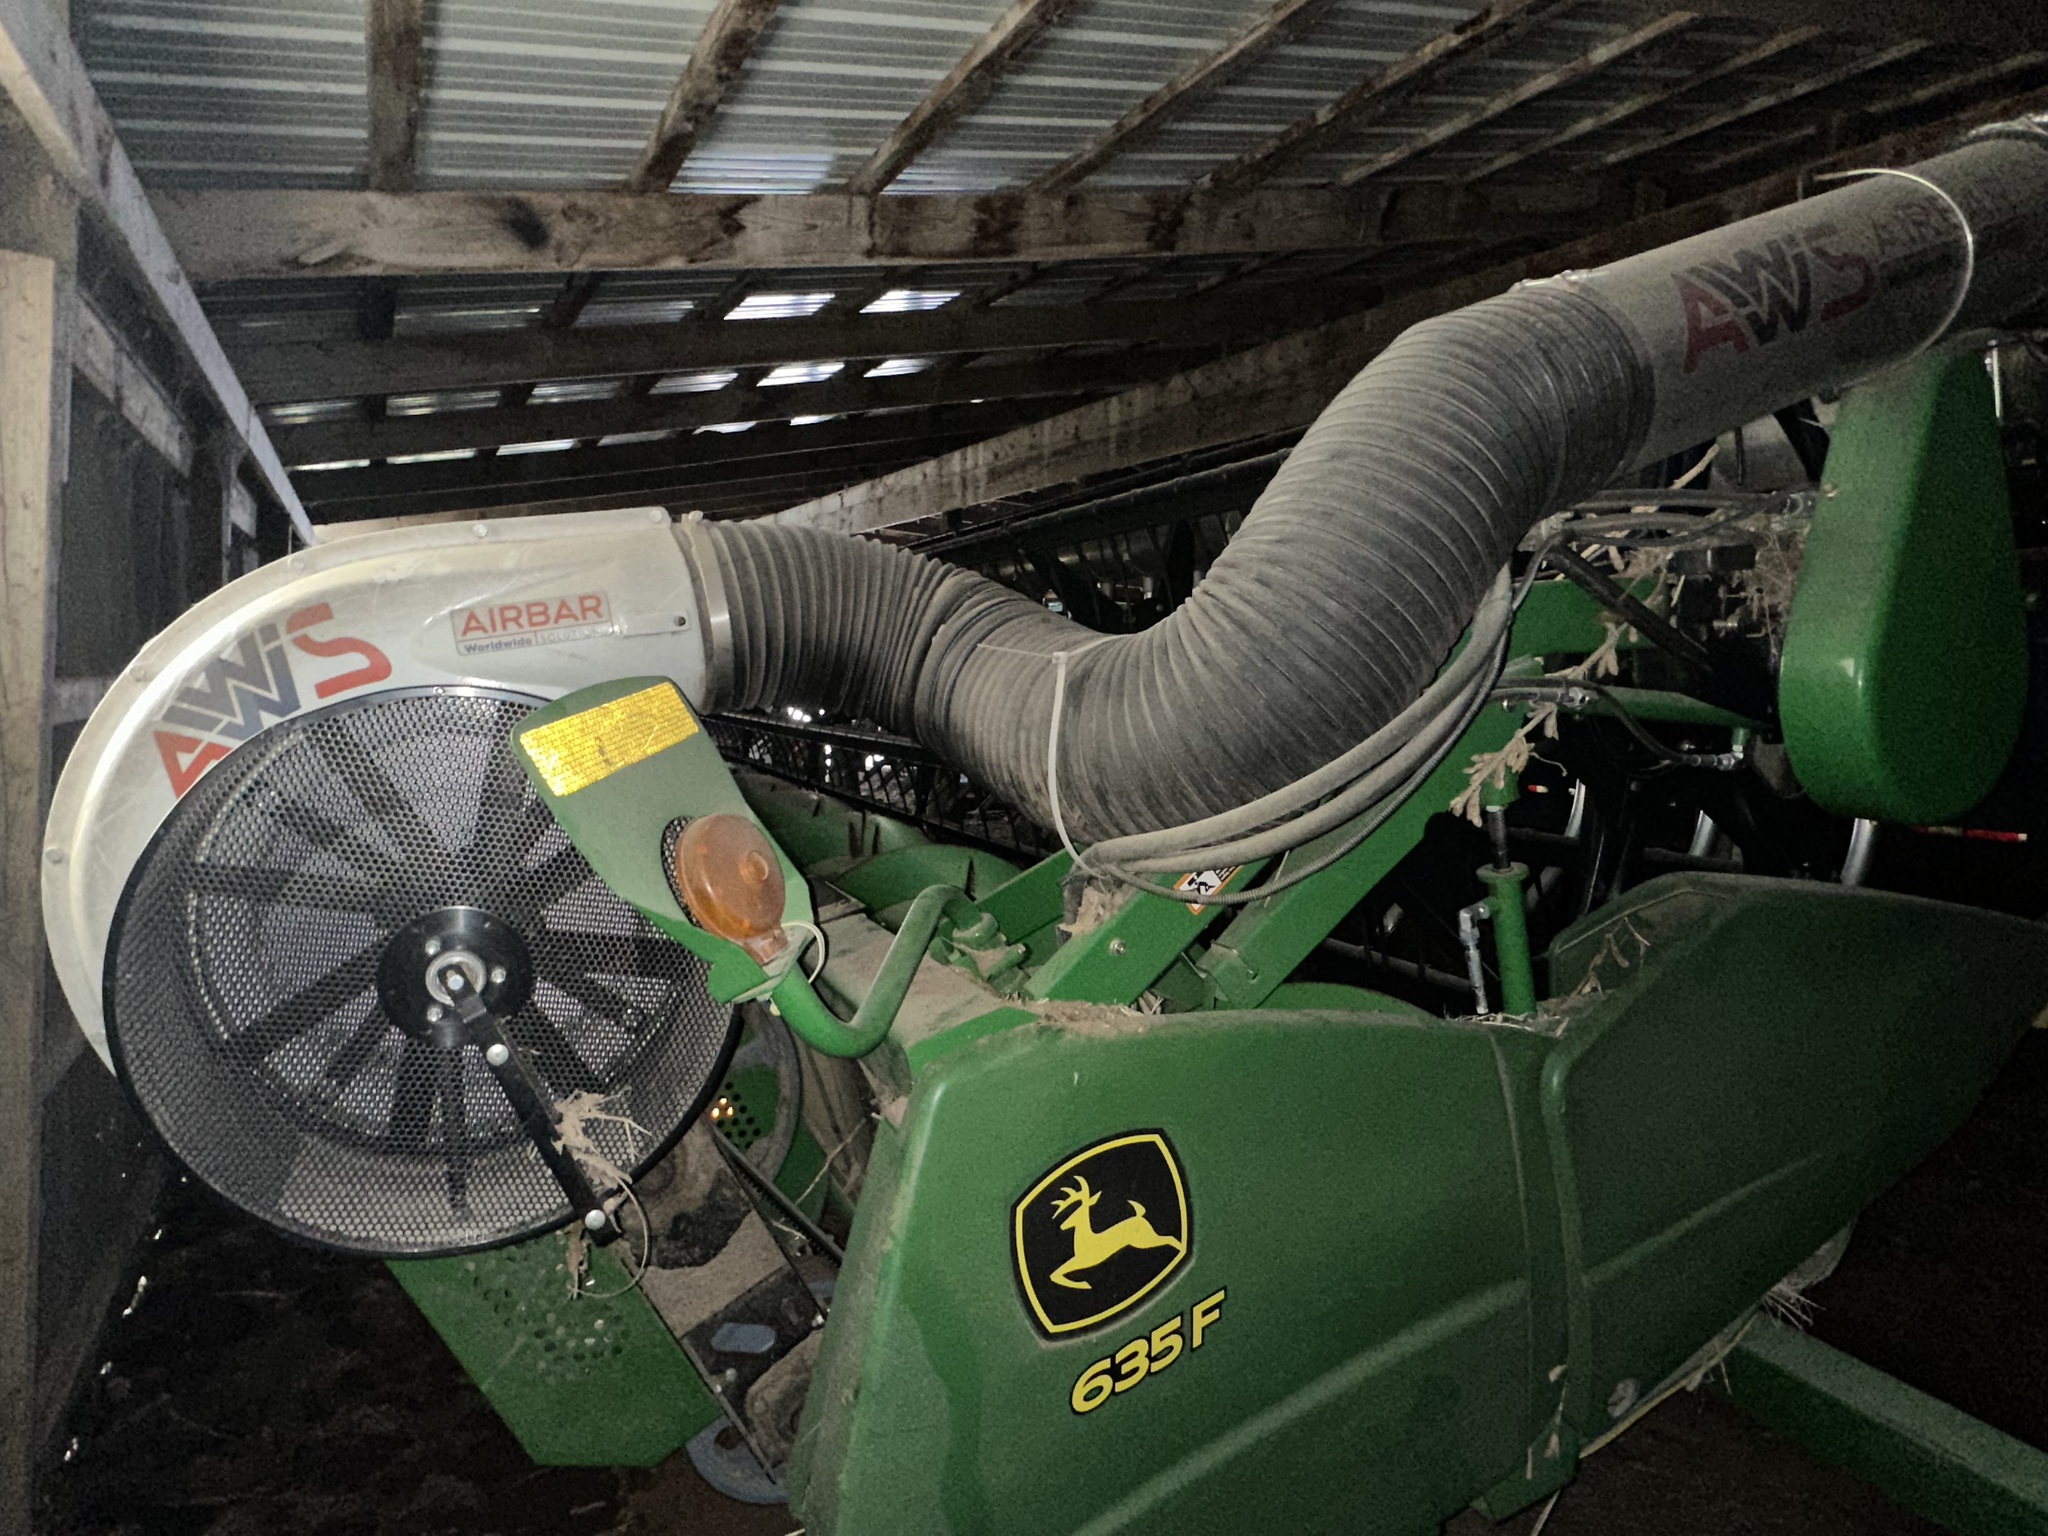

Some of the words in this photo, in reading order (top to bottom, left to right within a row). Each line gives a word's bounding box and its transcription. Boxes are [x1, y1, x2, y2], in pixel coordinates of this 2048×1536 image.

[1672, 224, 1878, 373] AWS
[461, 595, 604, 637] AIRBAR
[464, 638, 532, 654] Worldwide
[154, 602, 392, 800] AWS
[1071, 1315, 1184, 1413] 635
[1191, 1287, 1229, 1351] F
